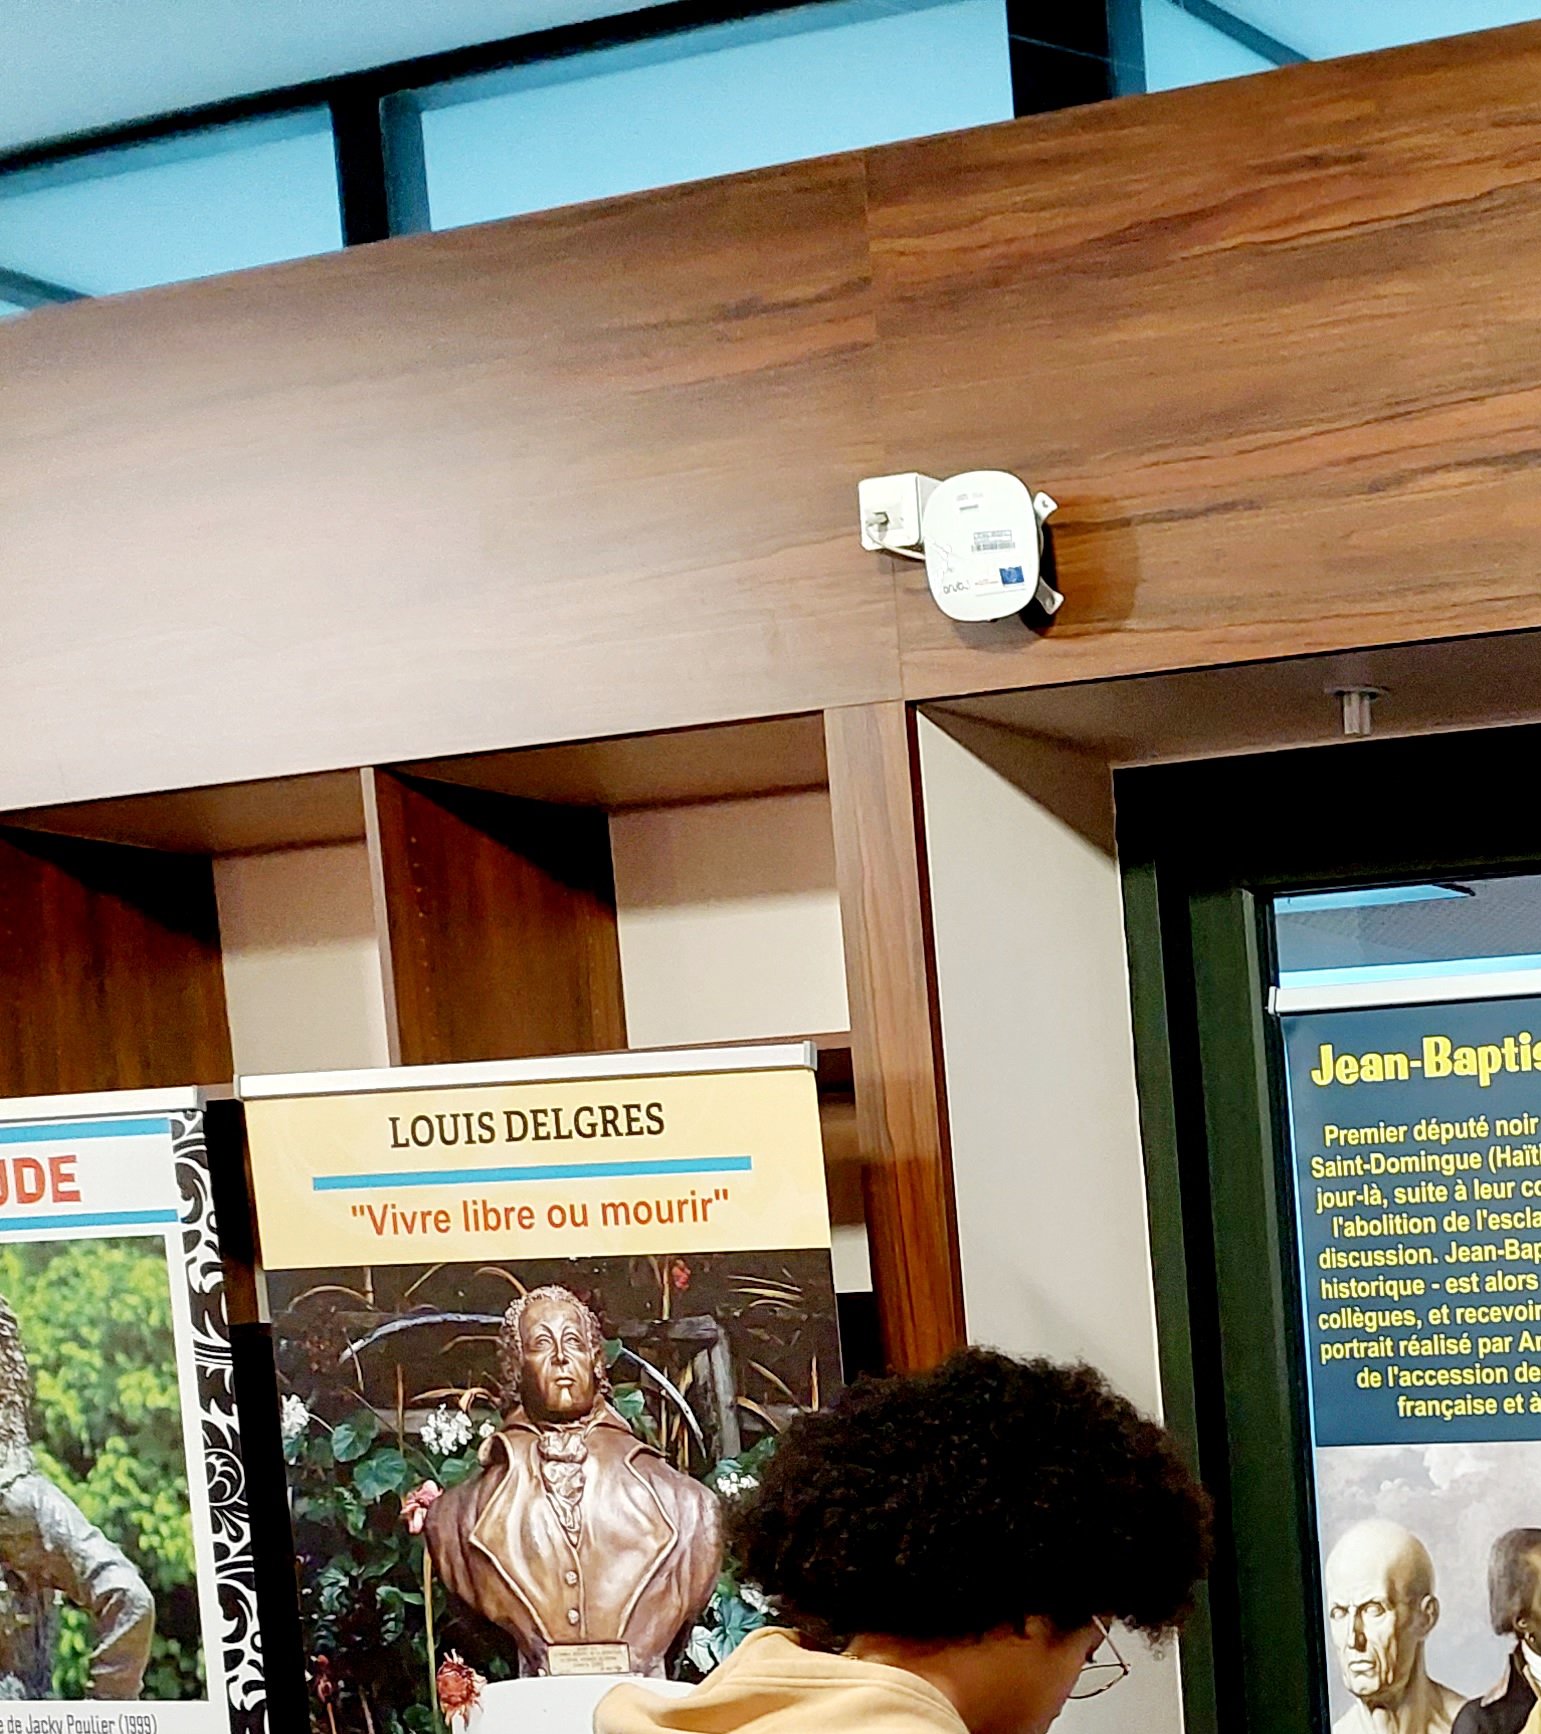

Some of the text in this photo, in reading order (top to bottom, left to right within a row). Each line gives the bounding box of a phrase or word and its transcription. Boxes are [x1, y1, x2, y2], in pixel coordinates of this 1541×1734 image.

[389, 1103, 664, 1148] LOUIS DELGRES
[1325, 1122, 1407, 1146] Premier
[1414, 1116, 1489, 1144] député
[1496, 1113, 1539, 1136] noir
[352, 1189, 728, 1235] "Vivre libre ou mourir"
[8, 1715, 22, 1734] de
[67, 1715, 115, 1734] Poulier
